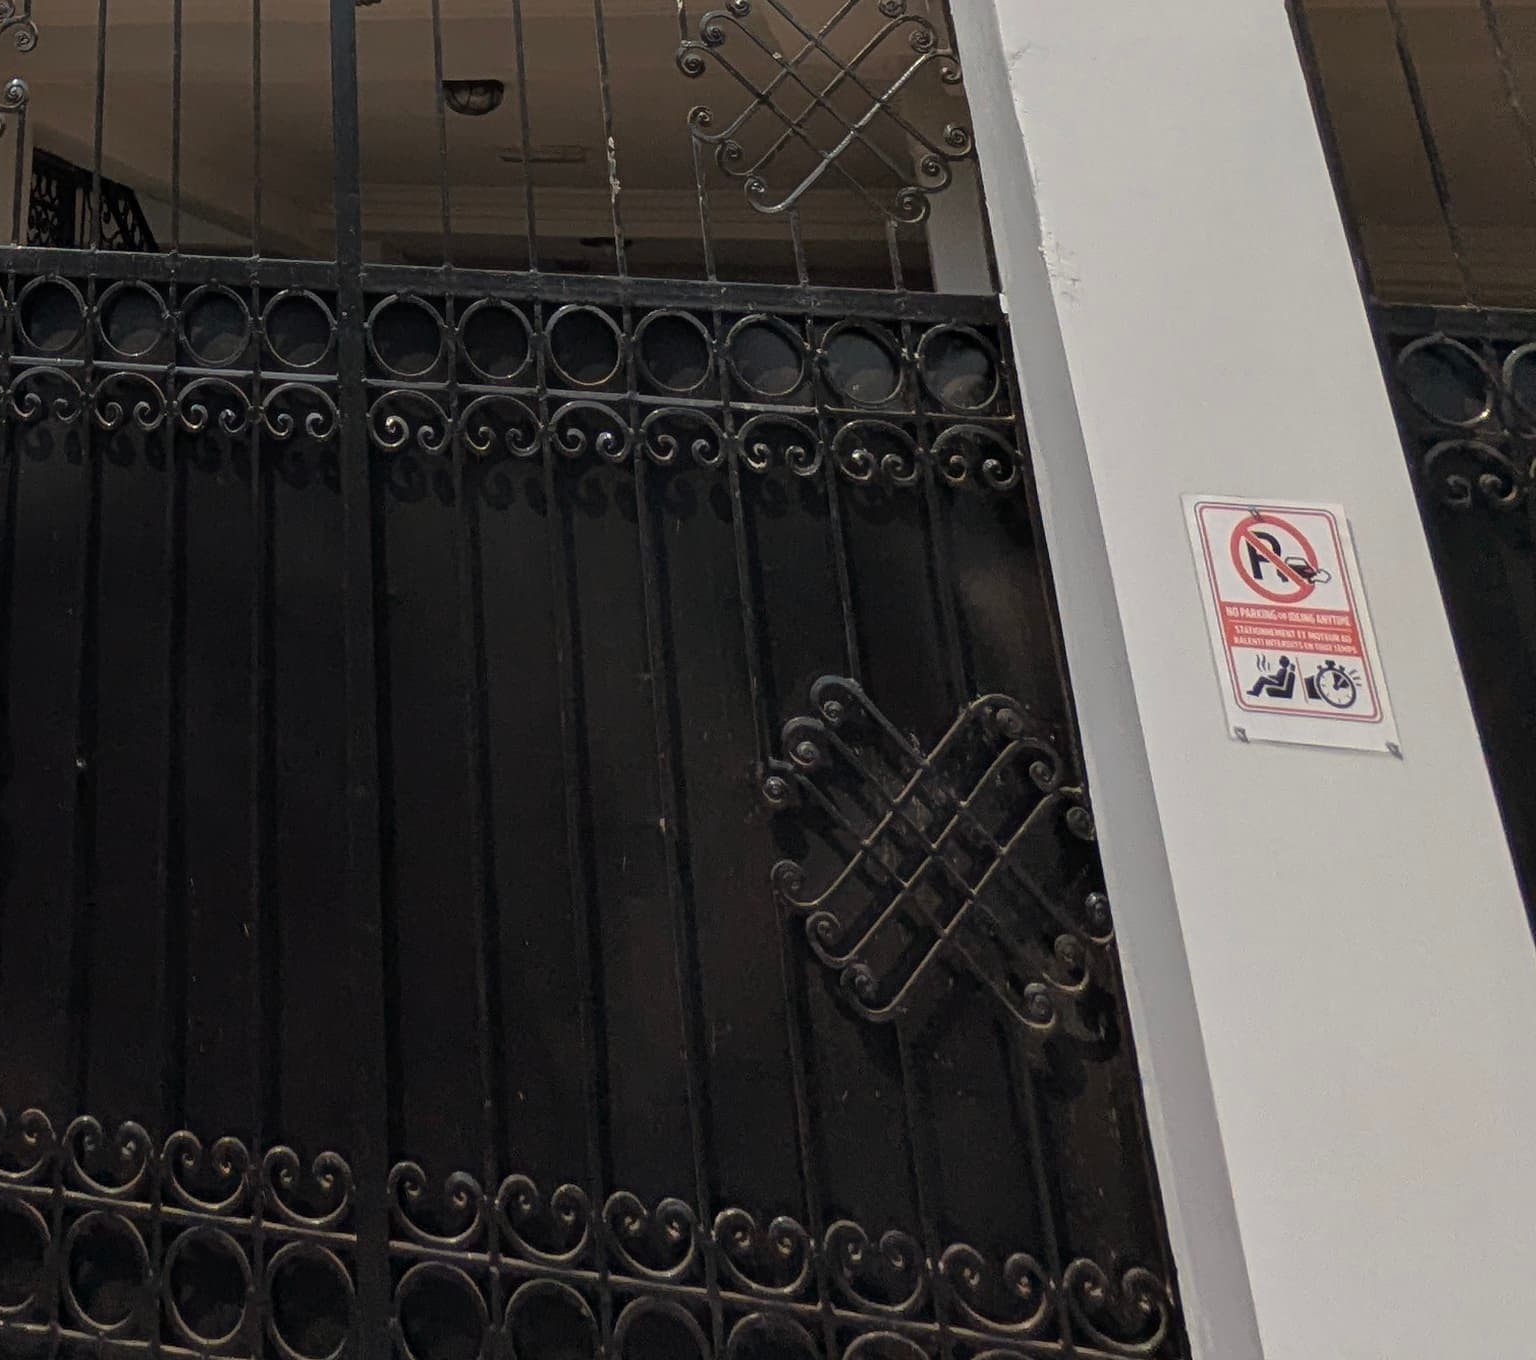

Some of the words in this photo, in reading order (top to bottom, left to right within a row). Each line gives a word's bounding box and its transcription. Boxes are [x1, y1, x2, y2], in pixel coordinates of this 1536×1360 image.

[1226, 607, 1239, 617] NO
[1240, 607, 1277, 620] PARKING
[1316, 614, 1350, 626] ANYTIME
